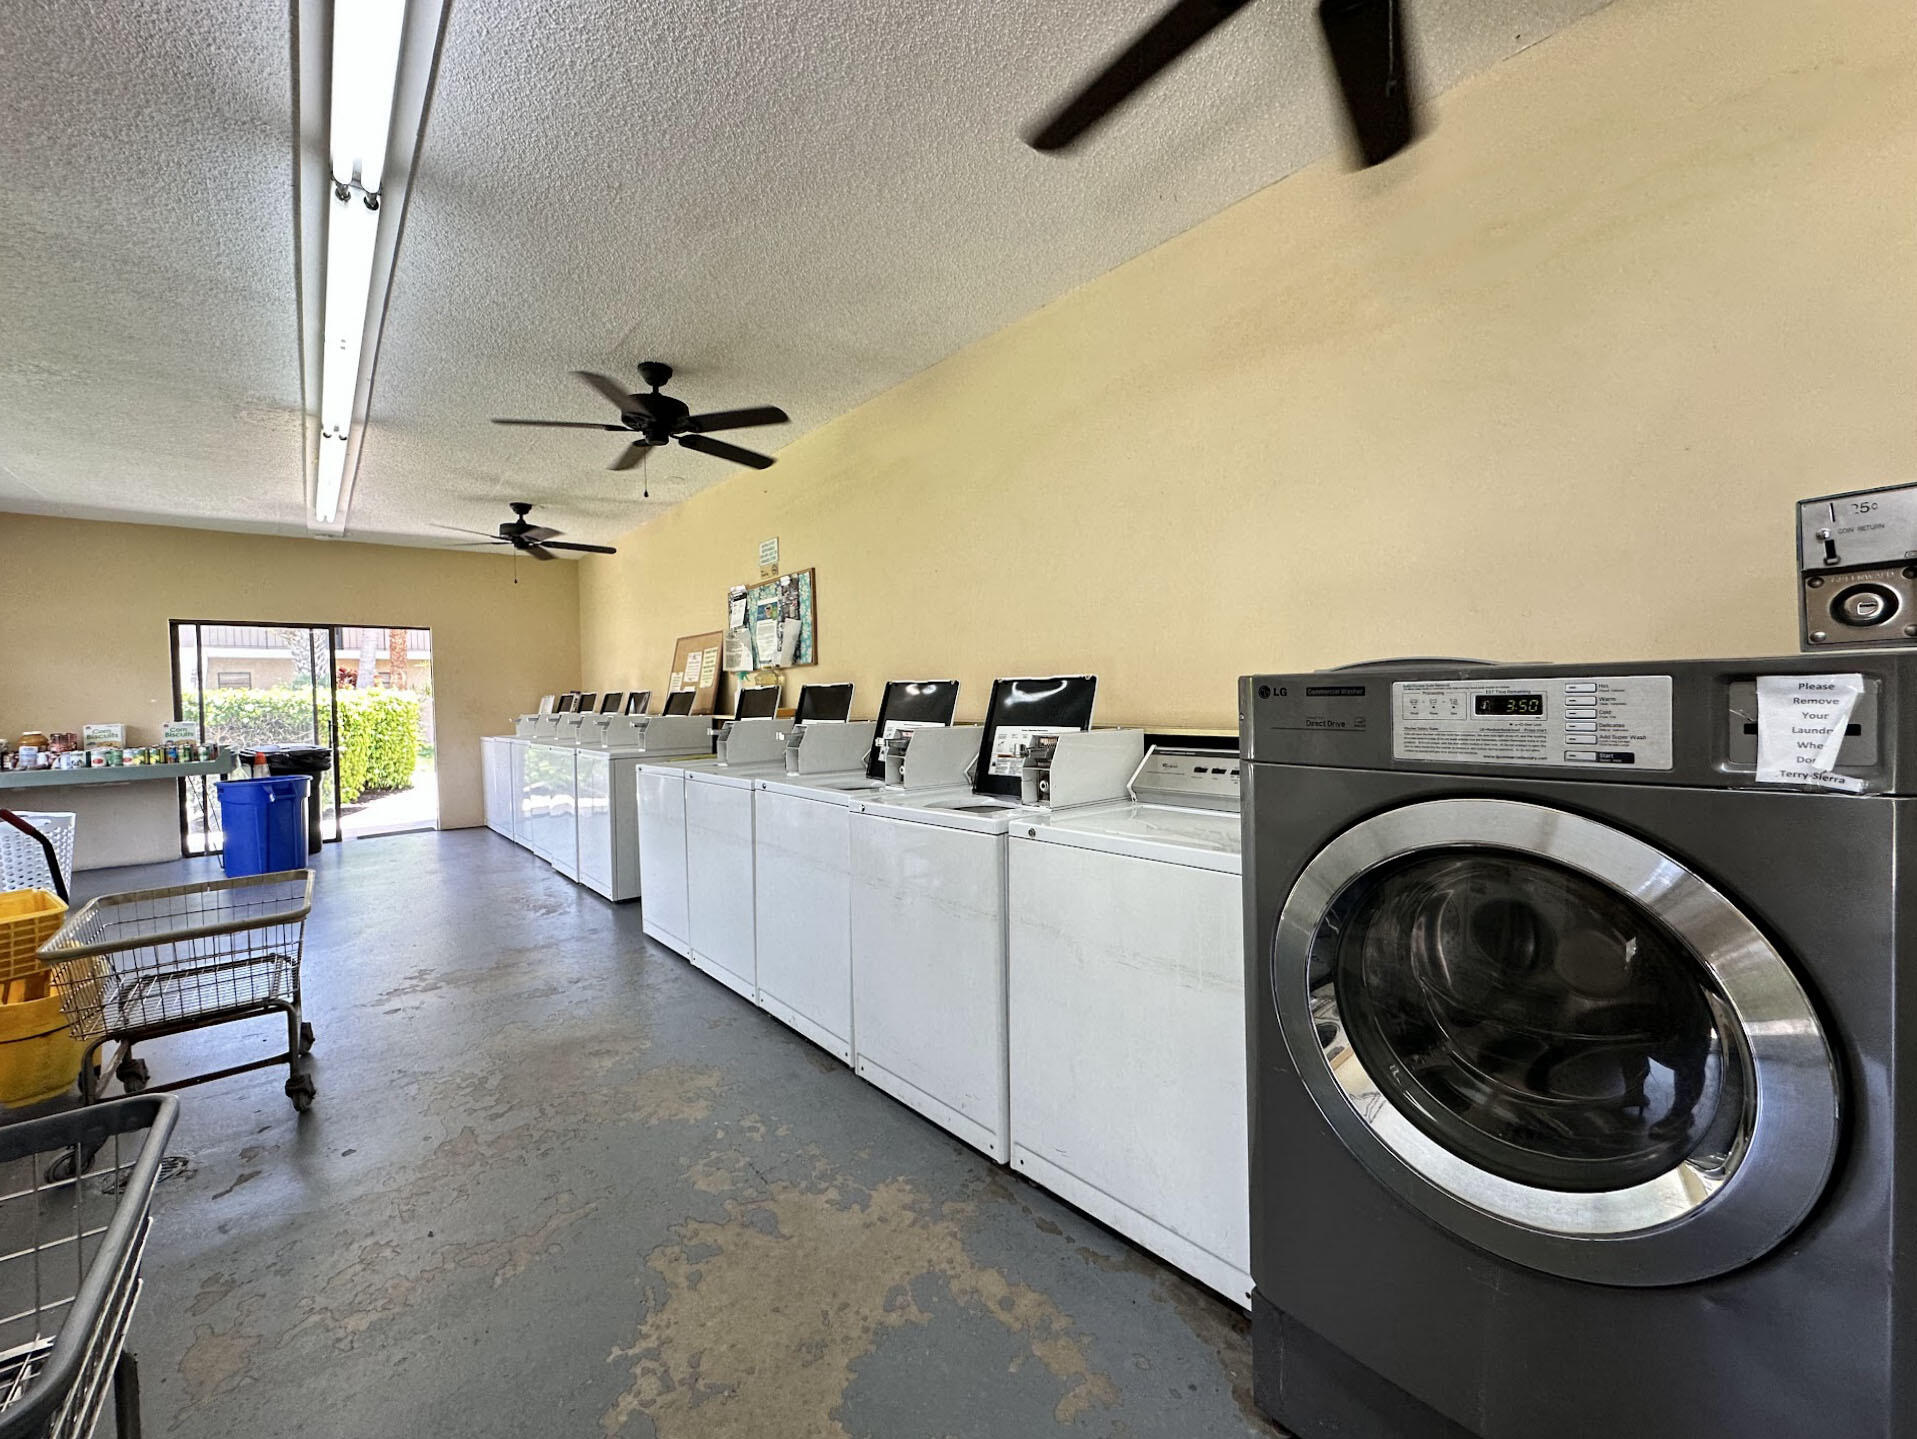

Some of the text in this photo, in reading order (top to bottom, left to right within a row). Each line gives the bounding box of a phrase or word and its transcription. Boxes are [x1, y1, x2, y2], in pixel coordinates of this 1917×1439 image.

[1857, 523, 1885, 532] RETURN
[1798, 682, 1836, 691] Please
[1792, 697, 1840, 705] Remove
[1801, 712, 1830, 720] Your
[1306, 719, 1326, 728] Direct
[1327, 719, 1346, 728] Drive
[1791, 726, 1834, 735] Laundr
[86, 732, 119, 741] Biscuits
[1796, 741, 1824, 750] Whe
